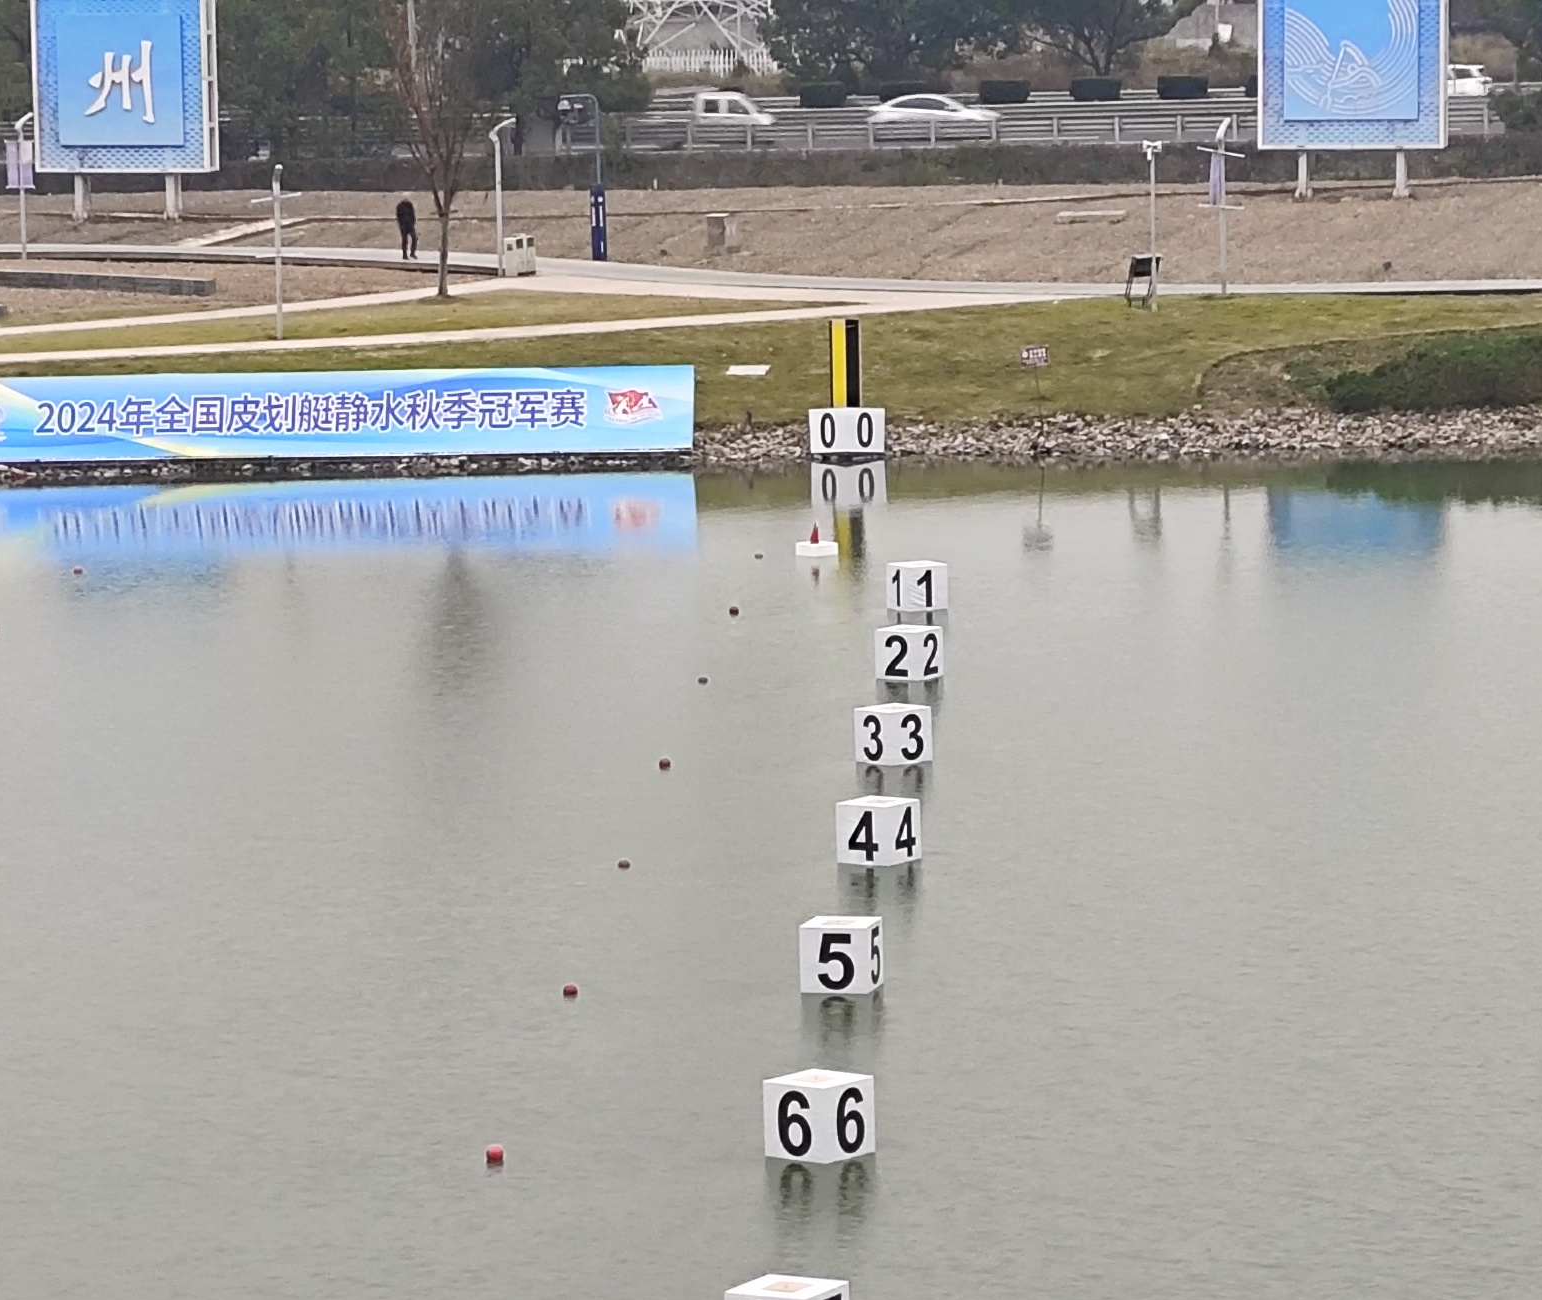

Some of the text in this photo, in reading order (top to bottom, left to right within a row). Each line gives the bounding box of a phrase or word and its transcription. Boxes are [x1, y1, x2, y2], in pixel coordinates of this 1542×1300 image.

[84, 40, 155, 124] 州
[36, 390, 585, 435] 2024年全国皮划艇静水秋季冠军赛
[820, 412, 874, 449] 0 0
[891, 569, 933, 608] 1 1
[884, 632, 939, 678] 2 2
[862, 713, 924, 762] 3 3
[848, 806, 917, 862] 4 4
[817, 925, 881, 991] 5 5
[777, 1086, 865, 1157] 6 6
